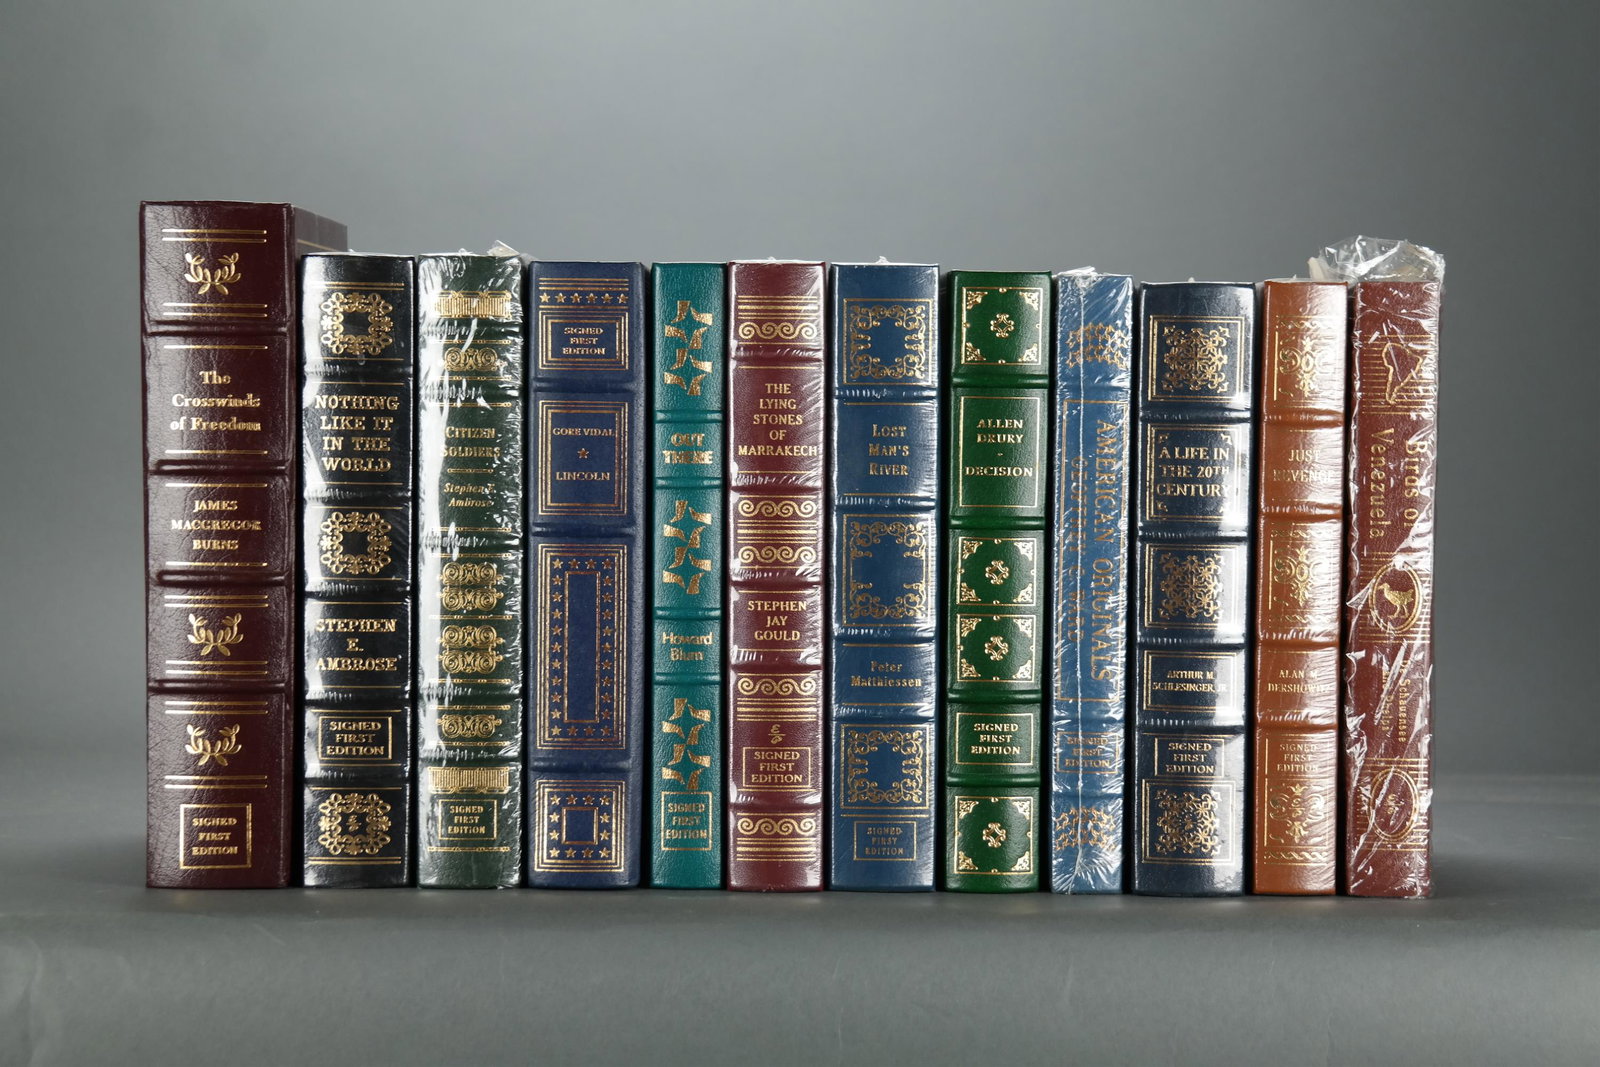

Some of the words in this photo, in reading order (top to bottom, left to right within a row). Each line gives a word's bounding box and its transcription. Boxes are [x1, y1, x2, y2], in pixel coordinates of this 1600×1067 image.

[564, 327, 603, 335] SIGNED
[570, 337, 598, 345] FIRST
[562, 347, 606, 356] EDITION
[200, 371, 231, 384] The
[765, 384, 791, 394] THE
[172, 394, 260, 408] Crosswinds
[315, 395, 400, 410] NOTHING
[759, 399, 796, 410] LYING
[170, 417, 185, 431] of
[191, 417, 261, 432] Freedom
[320, 417, 365, 430] LIKE
[373, 417, 394, 430] IT
[753, 414, 803, 426] STONES
[976, 419, 1024, 428] ALLEN
[446, 426, 496, 438] CITIZEN
[553, 428, 580, 436] GORE
[583, 428, 615, 436] VIDAL
[769, 430, 787, 440] OF
[872, 424, 907, 437] LOST
[671, 433, 705, 446] OUT
[977, 434, 1024, 444] DRURY
[322, 437, 344, 451] IN
[352, 438, 390, 452] THE
[441, 446, 500, 457] SOLDIERS
[738, 445, 818, 456] MARRAKECH
[1159, 447, 1170, 459] A
[1175, 447, 1209, 460] LIFE
[1214, 448, 1230, 460] IN
[662, 450, 714, 464] THERE
[1288, 450, 1320, 462] JUST
[322, 458, 391, 472] WORLD
[1404, 440, 1428, 498] Birds
[556, 472, 610, 481] LINCOLN
[966, 467, 1033, 477] DECISION
[1160, 465, 1192, 478] THE
[1196, 466, 1230, 478] 20TH
[1094, 420, 1117, 543] AMERICAN
[1370, 428, 1394, 538] Venezuela
[444, 482, 485, 494] Stephen
[1156, 484, 1232, 496] CENTURY
[194, 501, 238, 512] JAMES
[448, 498, 494, 507] Ambrose
[1069, 456, 1088, 555] GEOFFREY
[172, 520, 261, 531] MACGREGOR
[193, 540, 238, 550] BURNS
[748, 601, 808, 611] STEPHEN
[1068, 590, 1085, 642] WARD
[1090, 558, 1114, 680] ORIGINALS
[316, 618, 397, 632] STEPHEN
[766, 616, 788, 628] JAY
[662, 632, 714, 644] Howard
[754, 631, 800, 640] GOULD
[347, 638, 364, 652] E.
[670, 648, 704, 660] Blum
[315, 658, 398, 671] AMBROSE
[871, 660, 902, 672] Peter
[1167, 670, 1203, 679] ARTHUR
[1279, 670, 1304, 678] ALAN
[851, 676, 922, 687] Matthiessen
[1399, 679, 1411, 742] Schauensee
[330, 722, 381, 731] SIGNED
[974, 724, 1018, 732] SIGNED
[335, 734, 375, 743] FIRST
[980, 734, 1012, 742] FIRST
[1067, 737, 1108, 746] SIGNED
[326, 746, 384, 756] EDITION
[970, 746, 1020, 754] EDITION
[1072, 748, 1103, 756] FIRST
[1168, 743, 1212, 751] SIGNED
[1280, 744, 1316, 752] SIGNED
[754, 752, 800, 760] SIGNED
[1174, 754, 1207, 762] FIRST
[1284, 754, 1312, 762] FIRST
[759, 763, 794, 771] FIRST
[1065, 759, 1110, 768] EDITION
[1277, 764, 1318, 772] EDITION
[1166, 765, 1214, 774] EDITION
[752, 774, 802, 783] EDITION
[450, 805, 484, 814] SIGNED
[668, 802, 705, 813] SIGNED
[192, 818, 237, 826] SIGNED
[454, 816, 480, 824] FIRST
[672, 815, 701, 826] FIRST
[448, 826, 486, 834] EDITION
[666, 828, 708, 839] EDITION
[199, 832, 231, 841] FIRST
[192, 846, 238, 855] EDITION
[865, 848, 904, 856] EDITION
